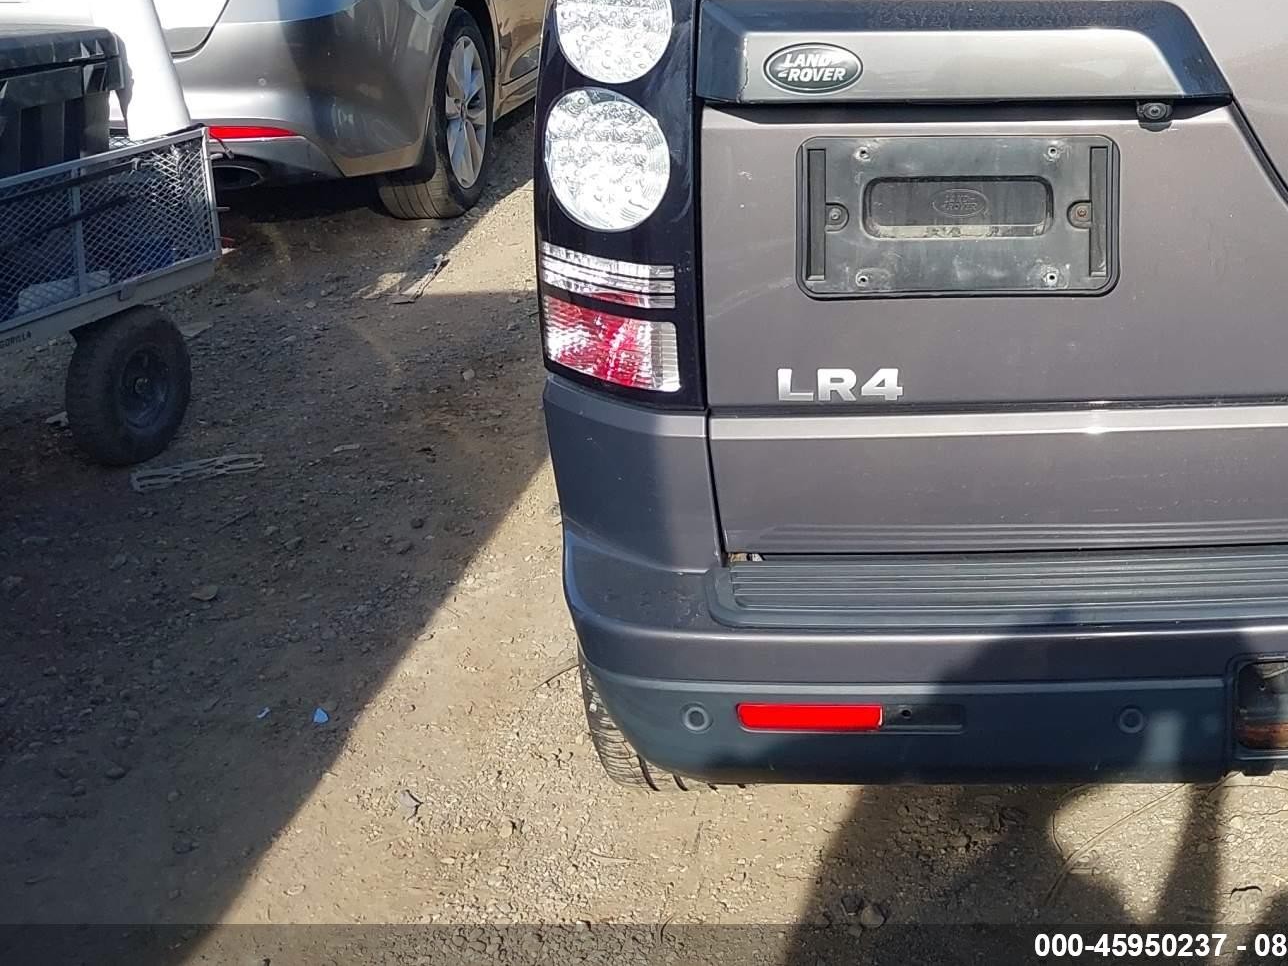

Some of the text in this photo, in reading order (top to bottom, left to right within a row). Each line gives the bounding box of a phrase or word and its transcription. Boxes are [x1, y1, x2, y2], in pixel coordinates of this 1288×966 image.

[783, 53, 832, 68] LAND
[787, 67, 847, 82] ROVER
[777, 367, 904, 402] LR4
